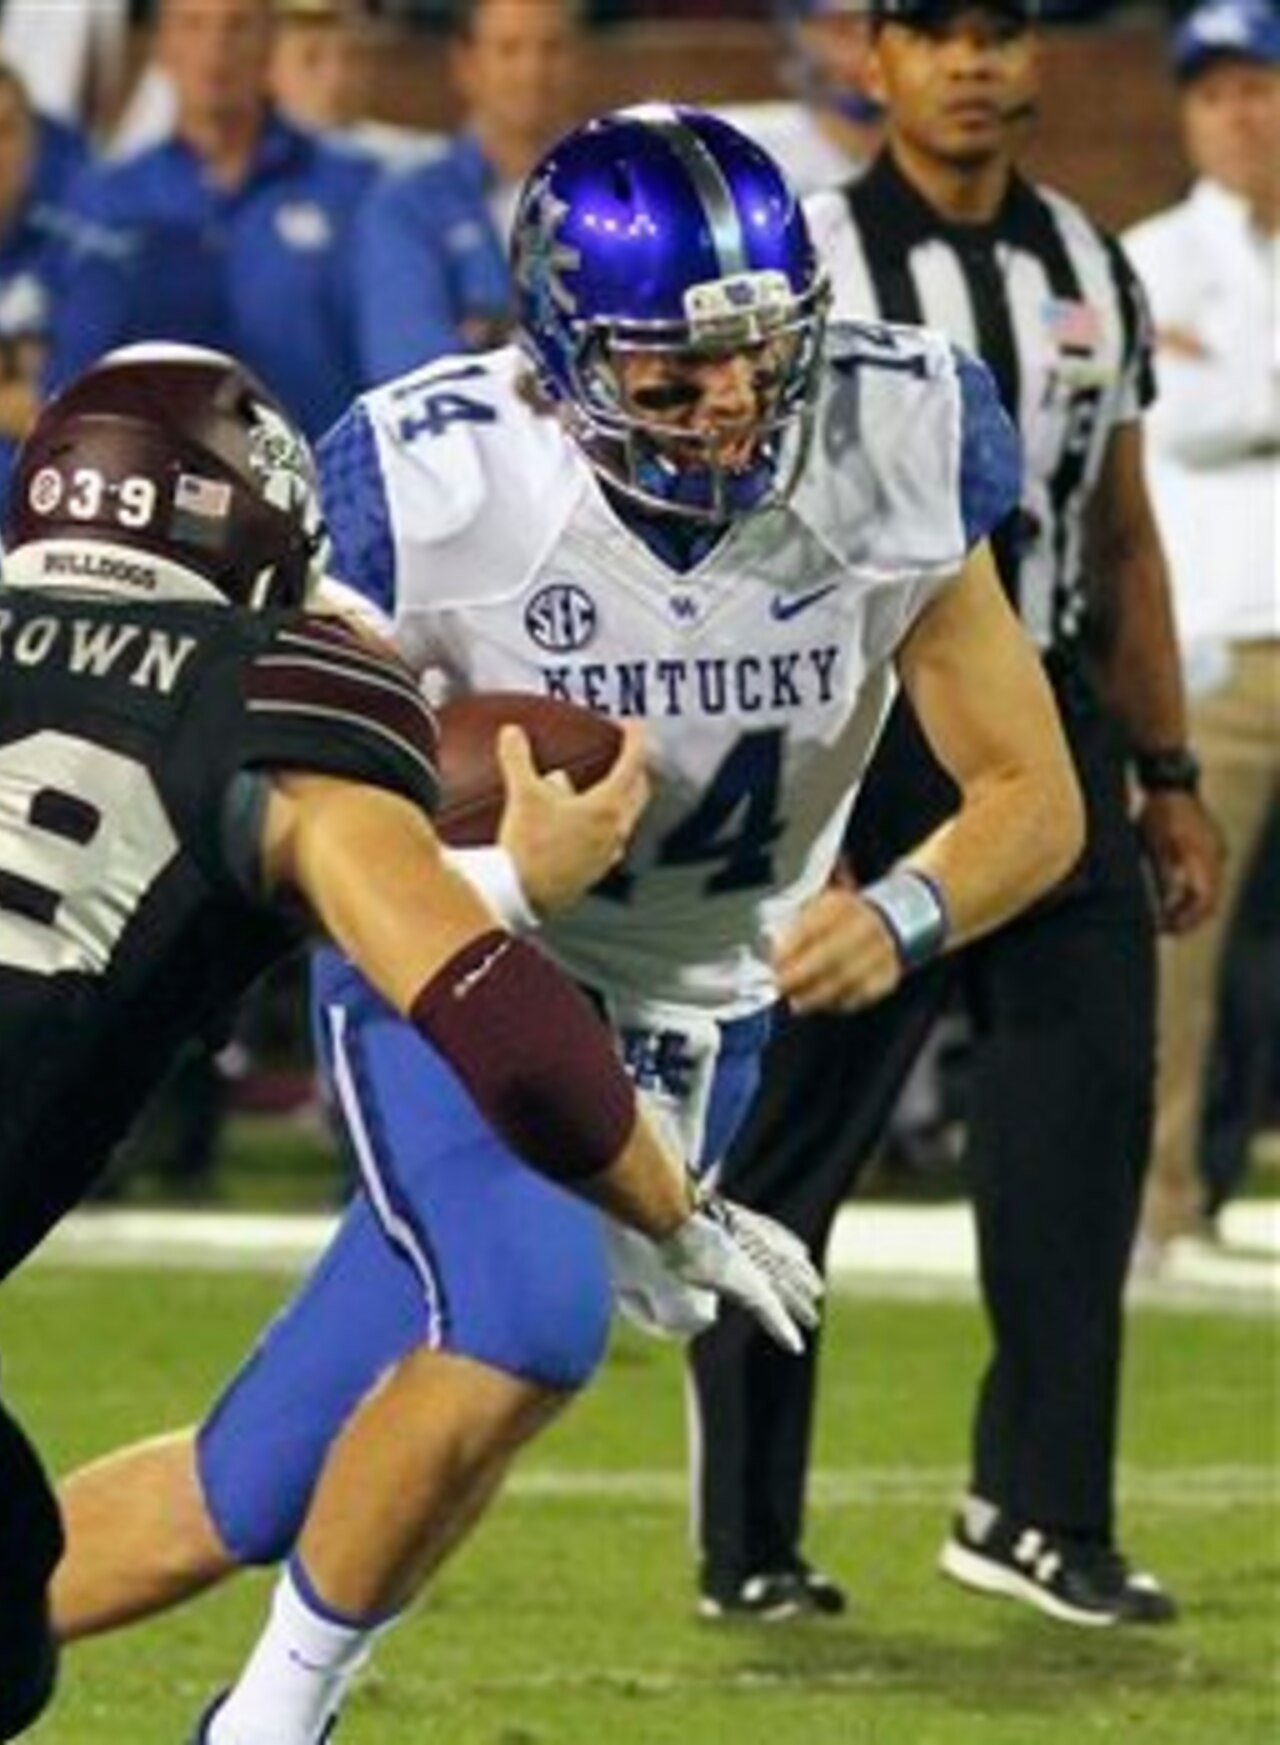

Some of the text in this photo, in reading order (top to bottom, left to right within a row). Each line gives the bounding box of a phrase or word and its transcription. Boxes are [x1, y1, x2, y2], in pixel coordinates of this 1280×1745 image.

[43, 551, 158, 591] BULLDOGS
[527, 586, 595, 653] SEC
[541, 646, 842, 718] KENTUCKY
[587, 724, 790, 905] 4
